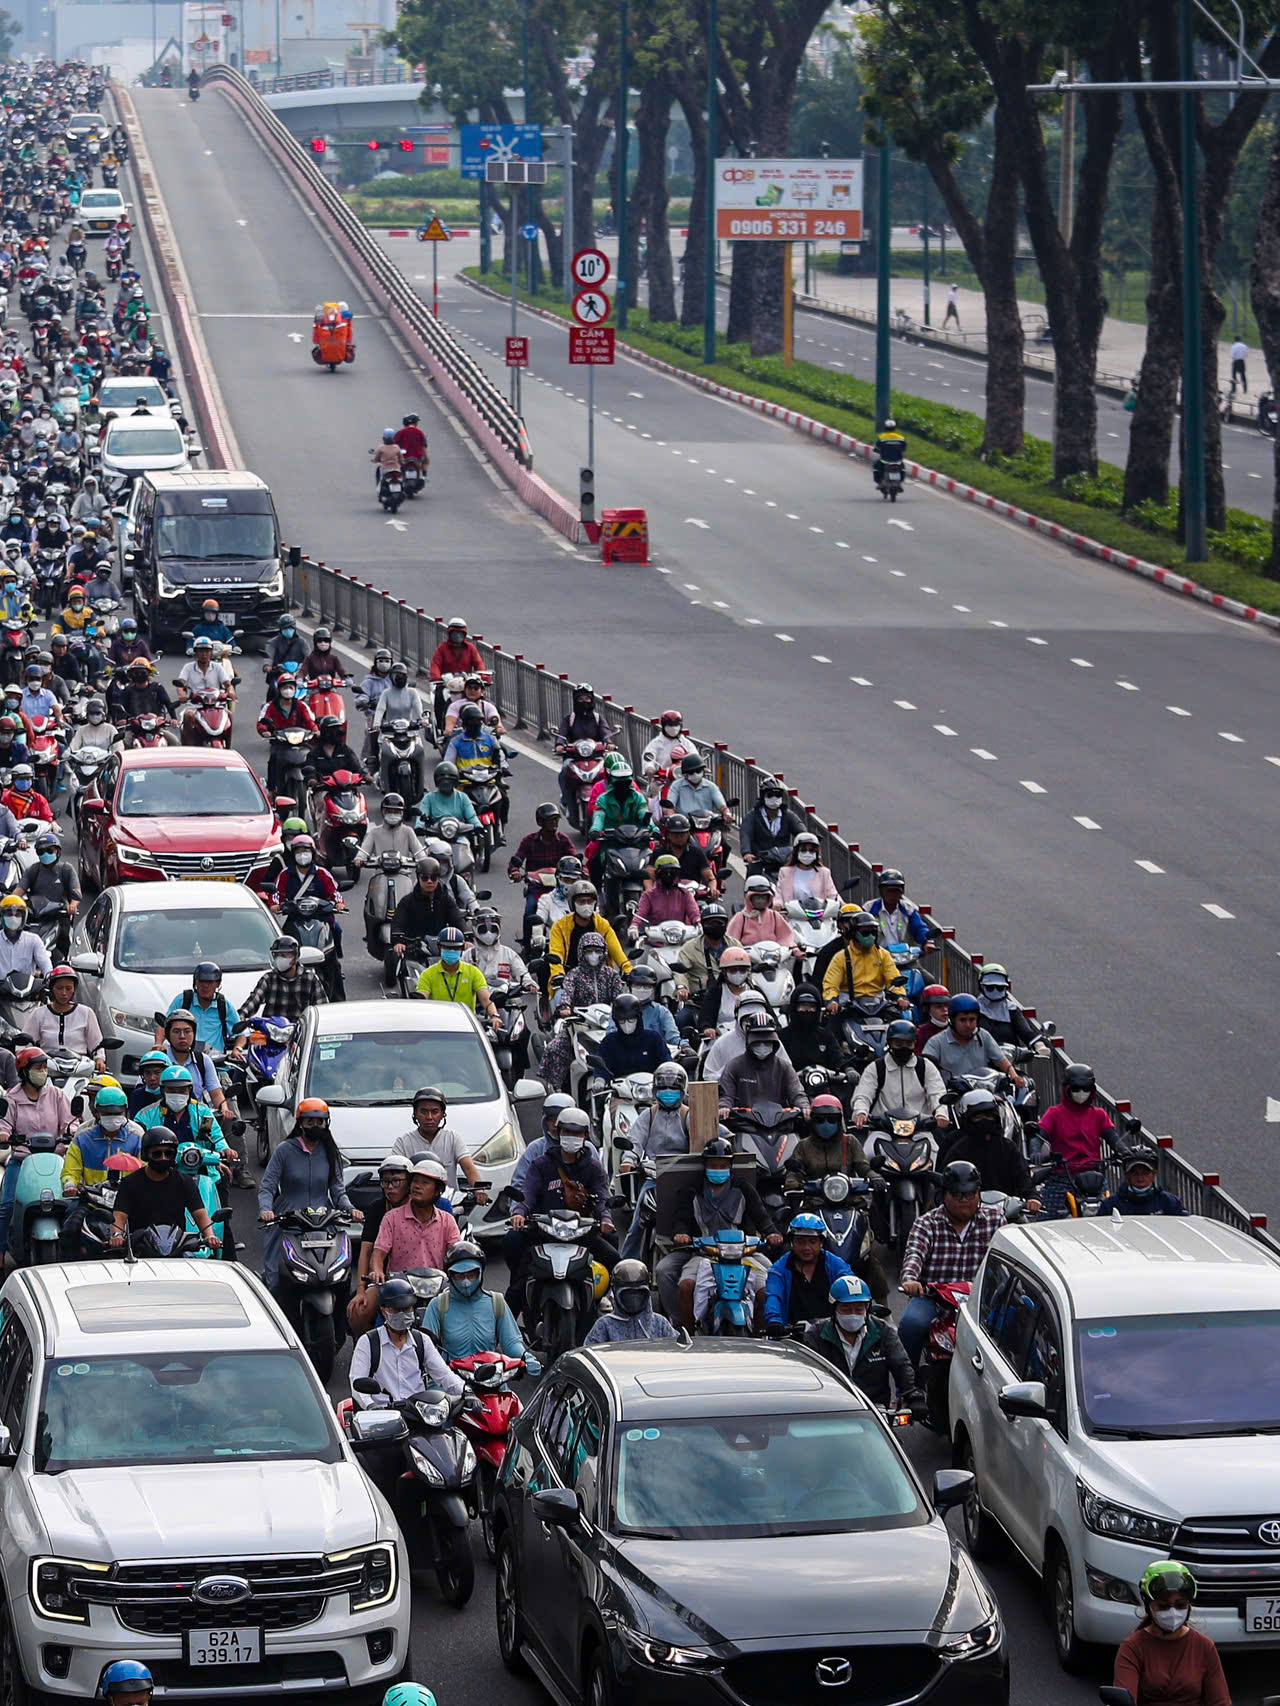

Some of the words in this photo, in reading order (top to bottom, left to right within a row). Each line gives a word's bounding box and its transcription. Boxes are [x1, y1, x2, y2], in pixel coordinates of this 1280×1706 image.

[730, 220, 772, 235] 0906
[778, 220, 808, 235] 331
[814, 220, 846, 235] 246
[208, 1584, 237, 1597] Ford
[1253, 1616, 1280, 1630] 690
[209, 1631, 240, 1646] 62A
[197, 1647, 253, 1664] 339.17
